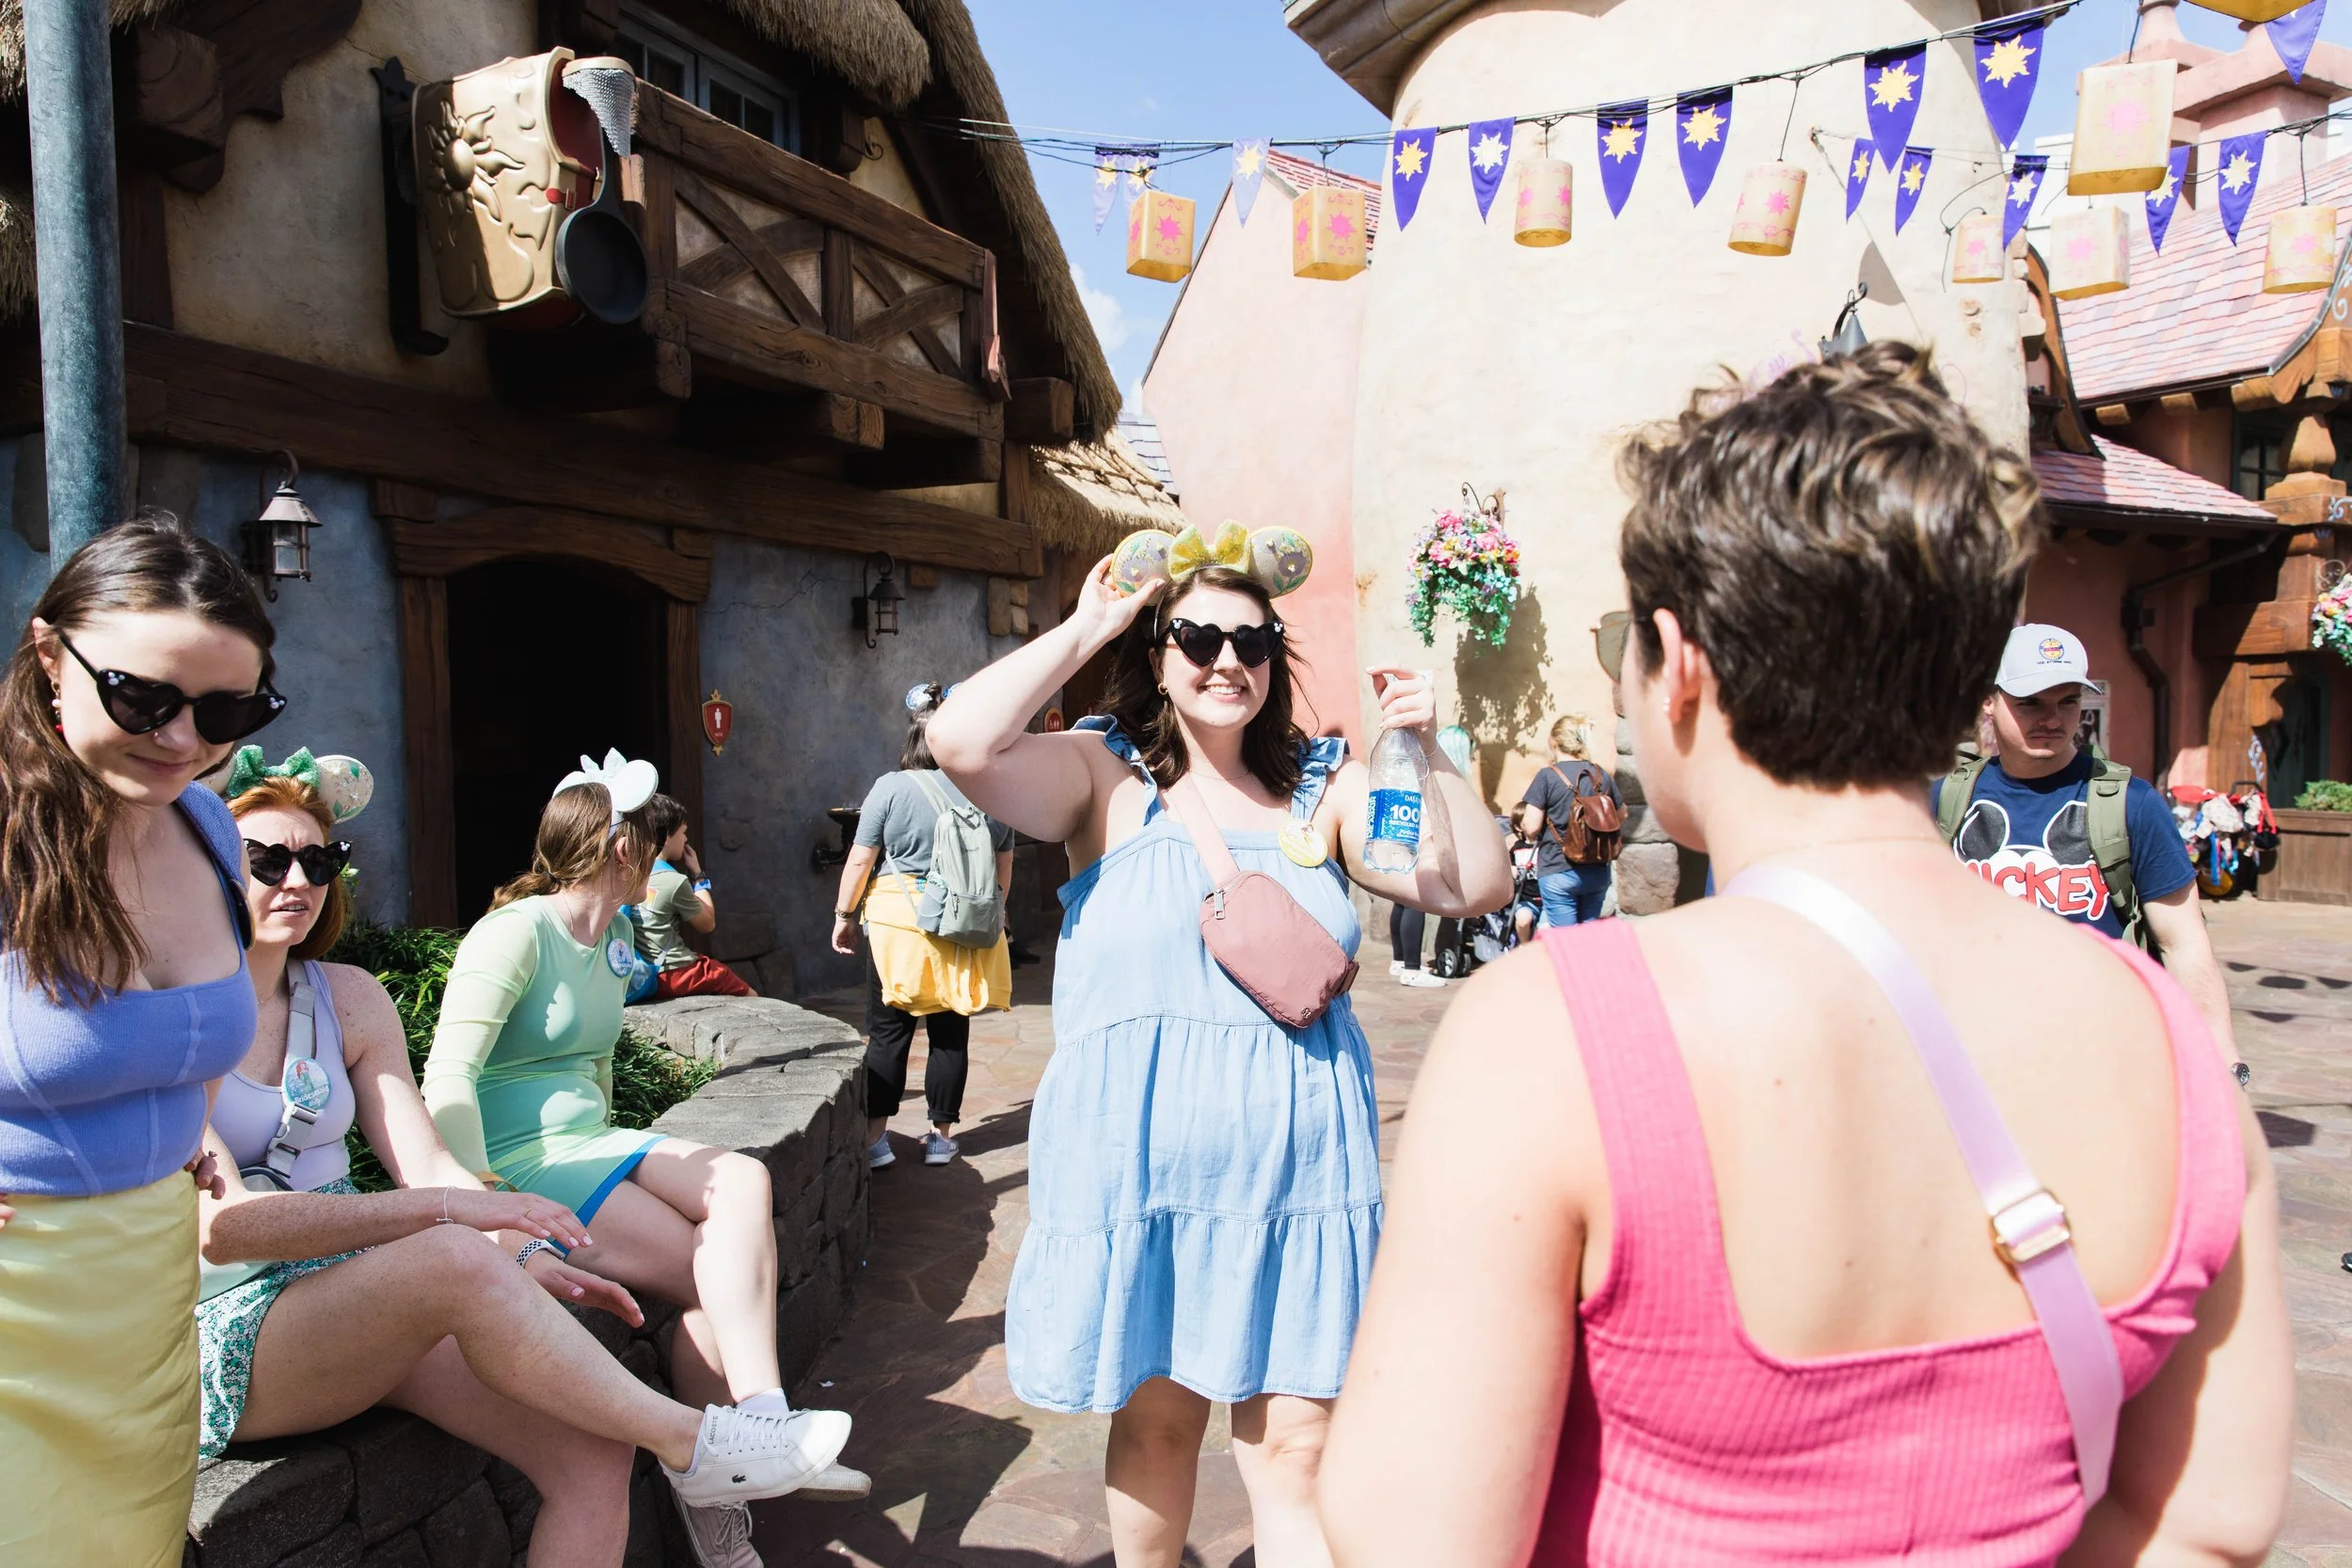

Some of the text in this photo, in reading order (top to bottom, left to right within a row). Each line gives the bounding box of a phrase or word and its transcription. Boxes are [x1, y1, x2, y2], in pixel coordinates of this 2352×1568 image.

[1389, 819, 1415, 828] RECYCLED
[294, 1083, 329, 1103] Bridesmaid
[708, 1415, 719, 1445] LACOSTE
